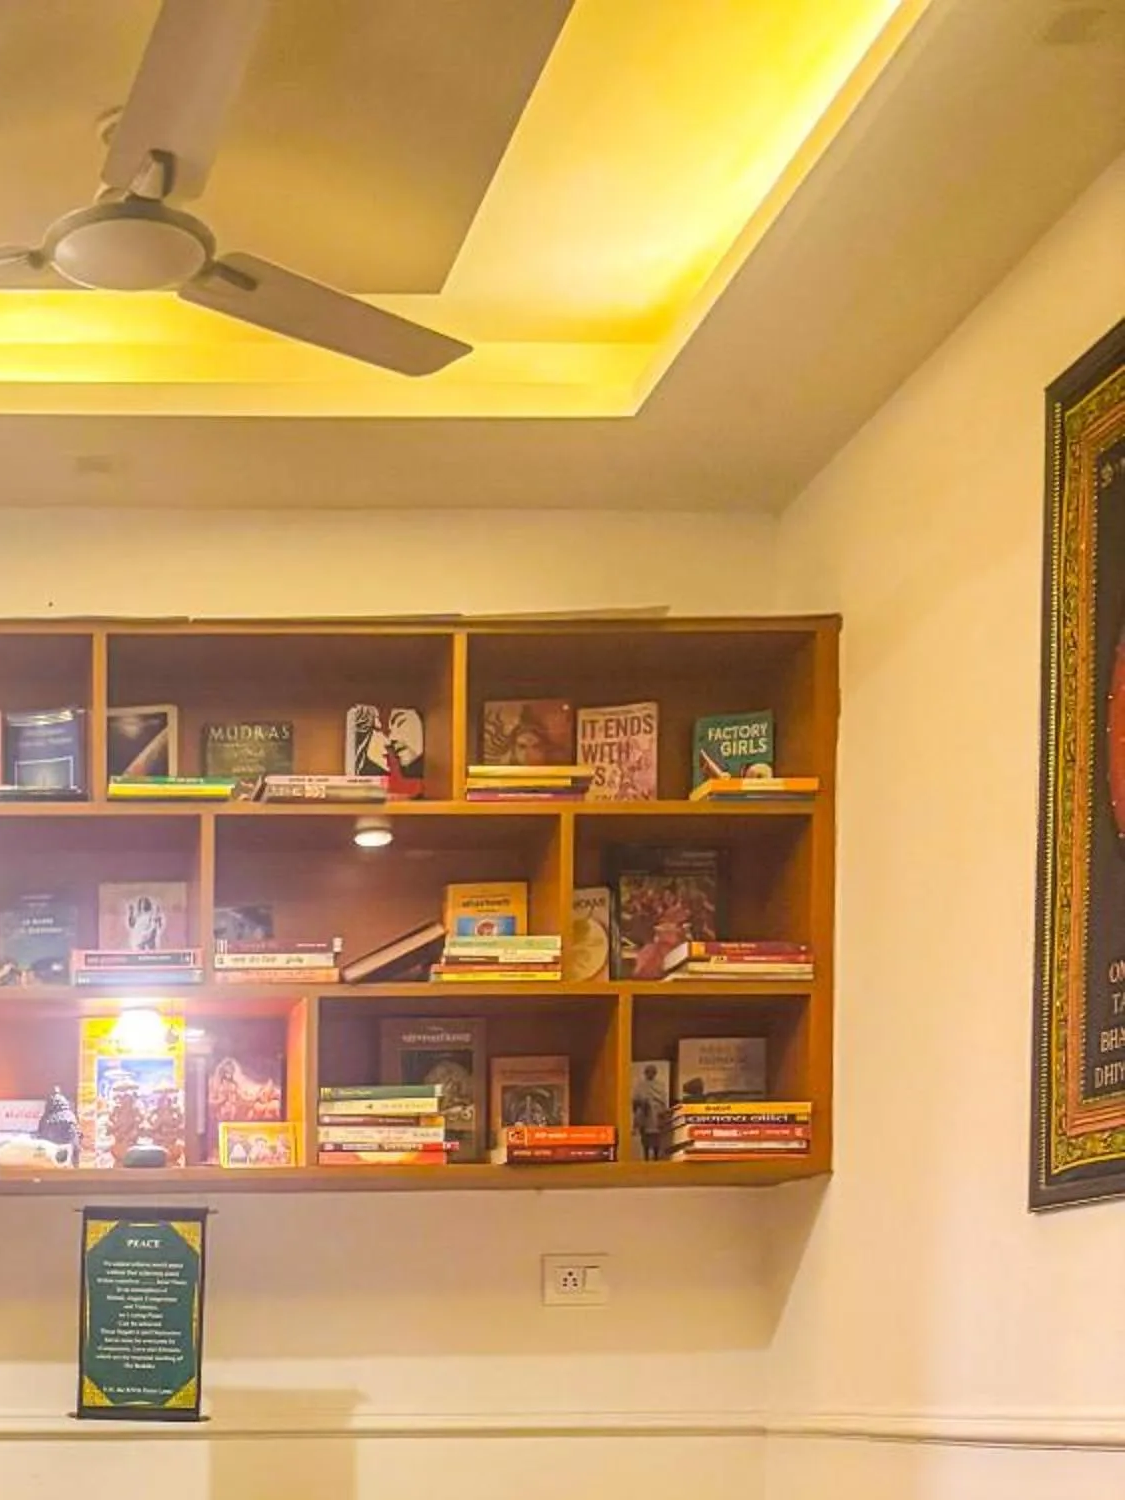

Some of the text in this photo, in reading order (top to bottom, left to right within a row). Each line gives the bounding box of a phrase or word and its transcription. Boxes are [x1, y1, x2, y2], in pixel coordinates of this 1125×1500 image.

[209, 725, 290, 740] MUDRAS
[581, 714, 654, 739] IT ENDS
[708, 722, 768, 741] FACTORY
[581, 740, 631, 764] WITH
[720, 738, 768, 756] GIRLS
[127, 1239, 161, 1249] PEACE
